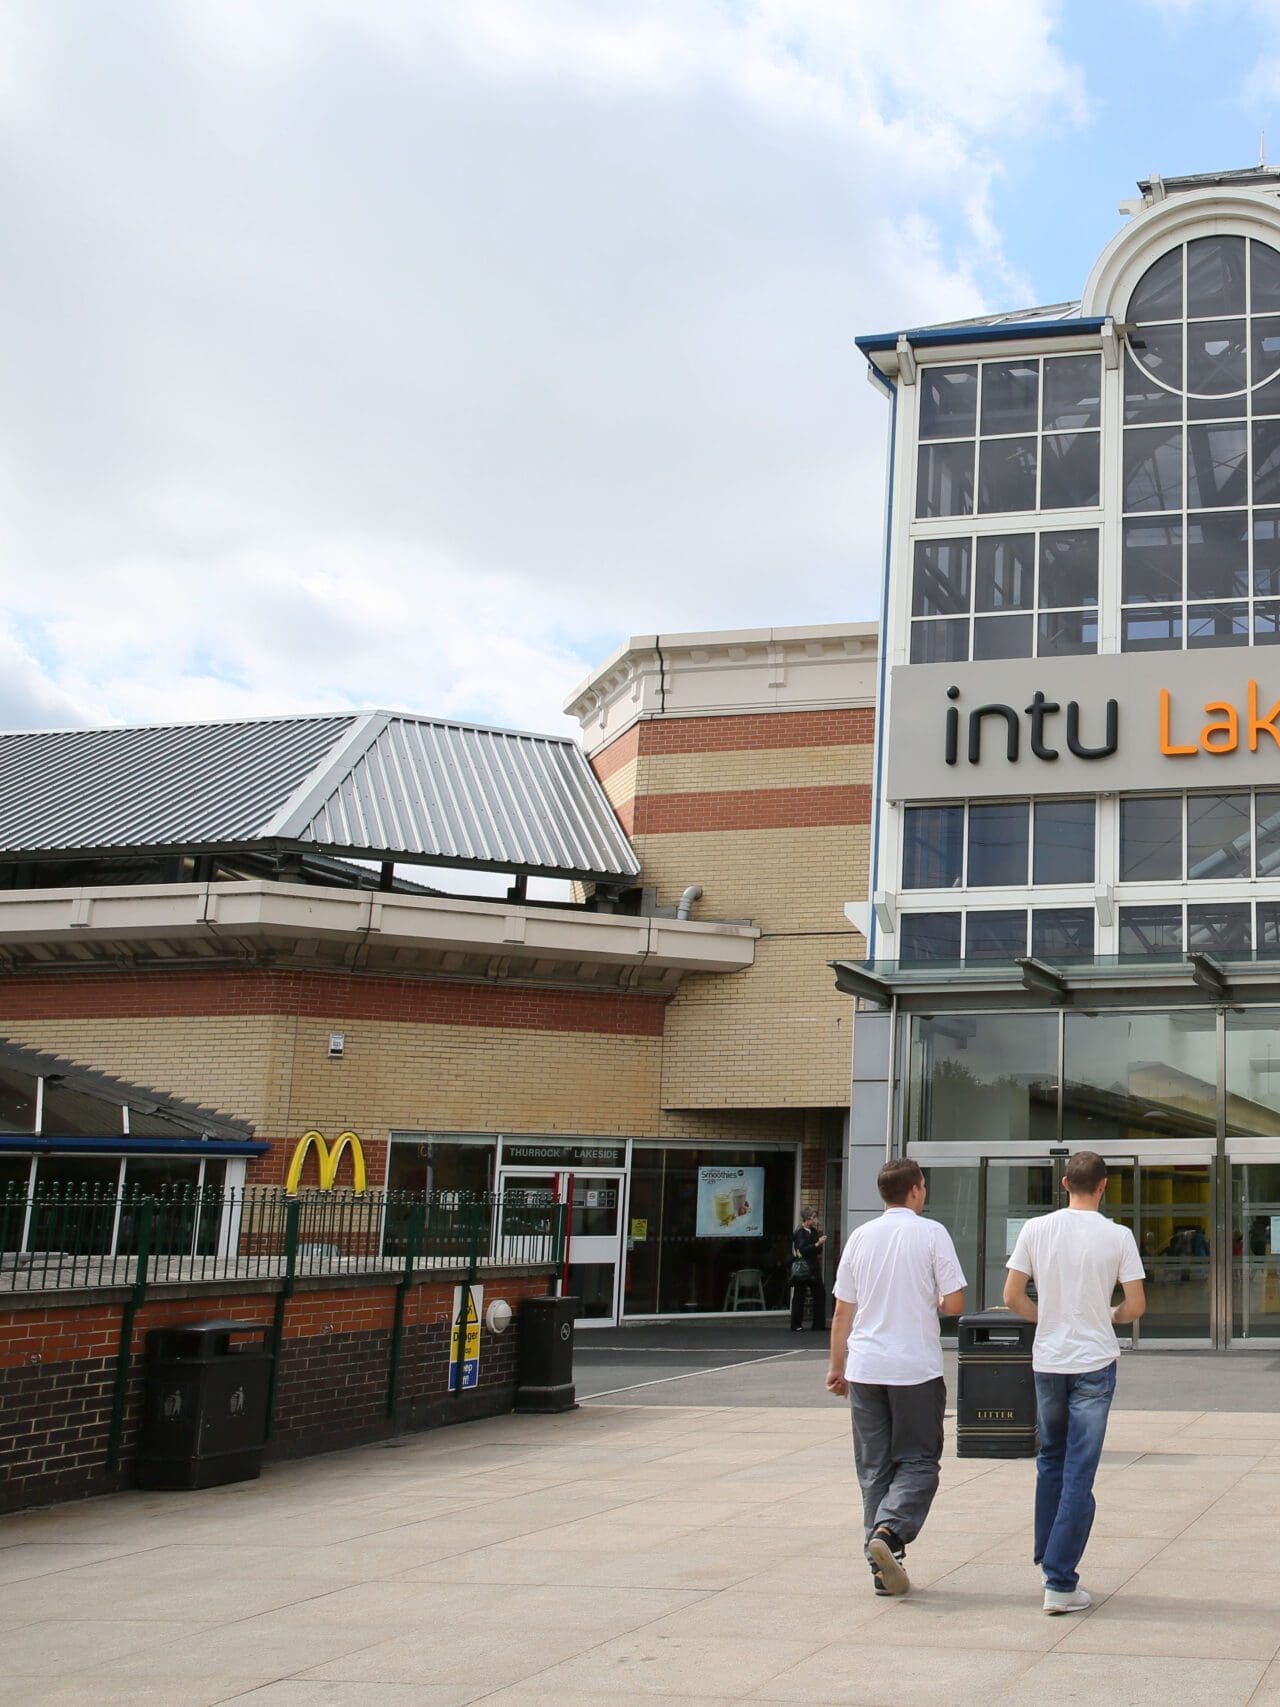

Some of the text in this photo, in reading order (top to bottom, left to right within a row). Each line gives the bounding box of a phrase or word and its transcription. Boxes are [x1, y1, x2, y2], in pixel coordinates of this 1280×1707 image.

[945, 685, 1118, 766] intu
[510, 1147, 560, 1157] THURROCK
[574, 1150, 618, 1158] LAKESIDE
[701, 1170, 737, 1178] Smoothies
[453, 1331, 478, 1342] Dger
